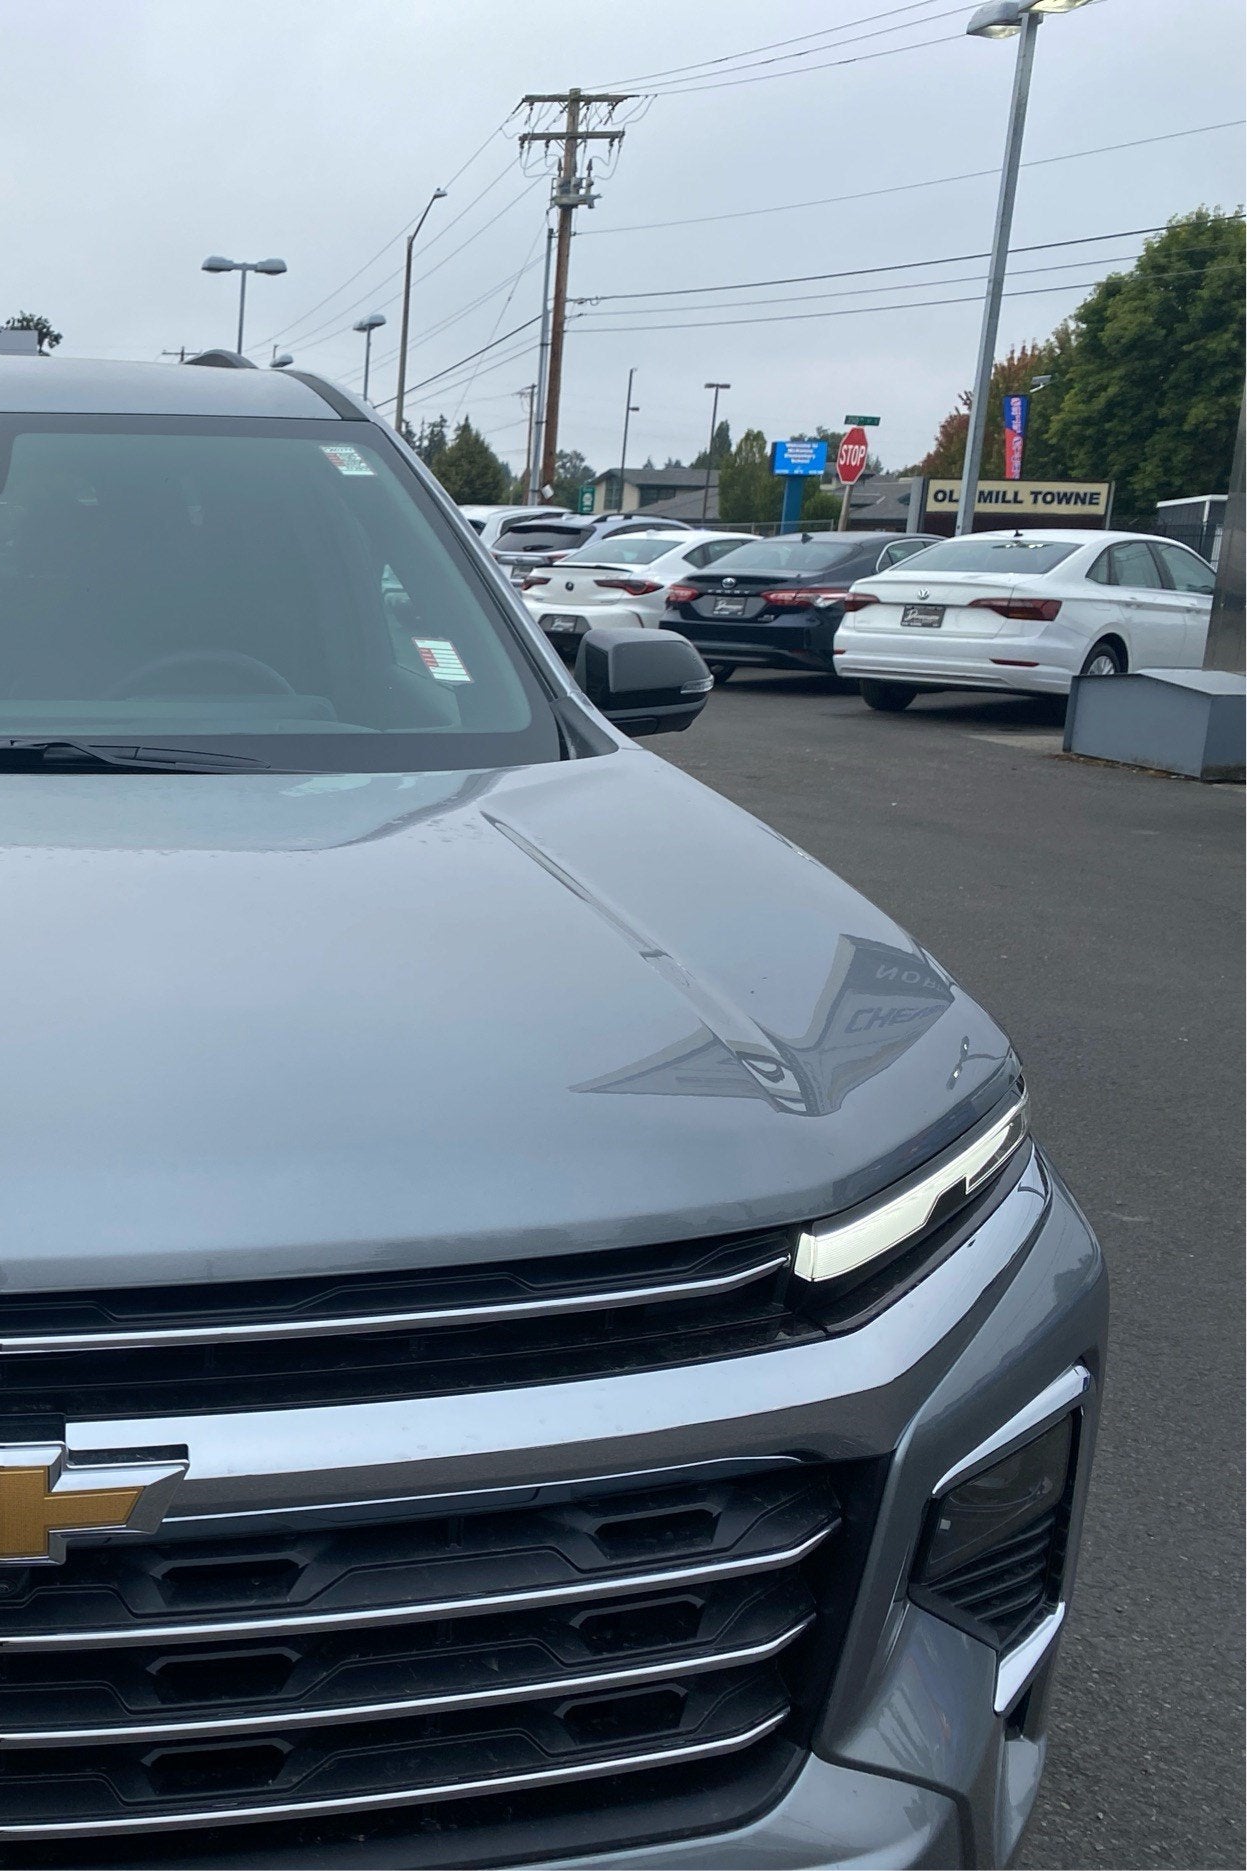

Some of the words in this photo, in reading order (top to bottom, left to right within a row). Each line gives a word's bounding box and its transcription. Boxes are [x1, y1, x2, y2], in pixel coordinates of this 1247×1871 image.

[839, 444, 866, 466] STOP
[933, 489, 960, 503] OL
[977, 490, 1024, 504] MILL
[1030, 491, 1101, 505] TOWNE
